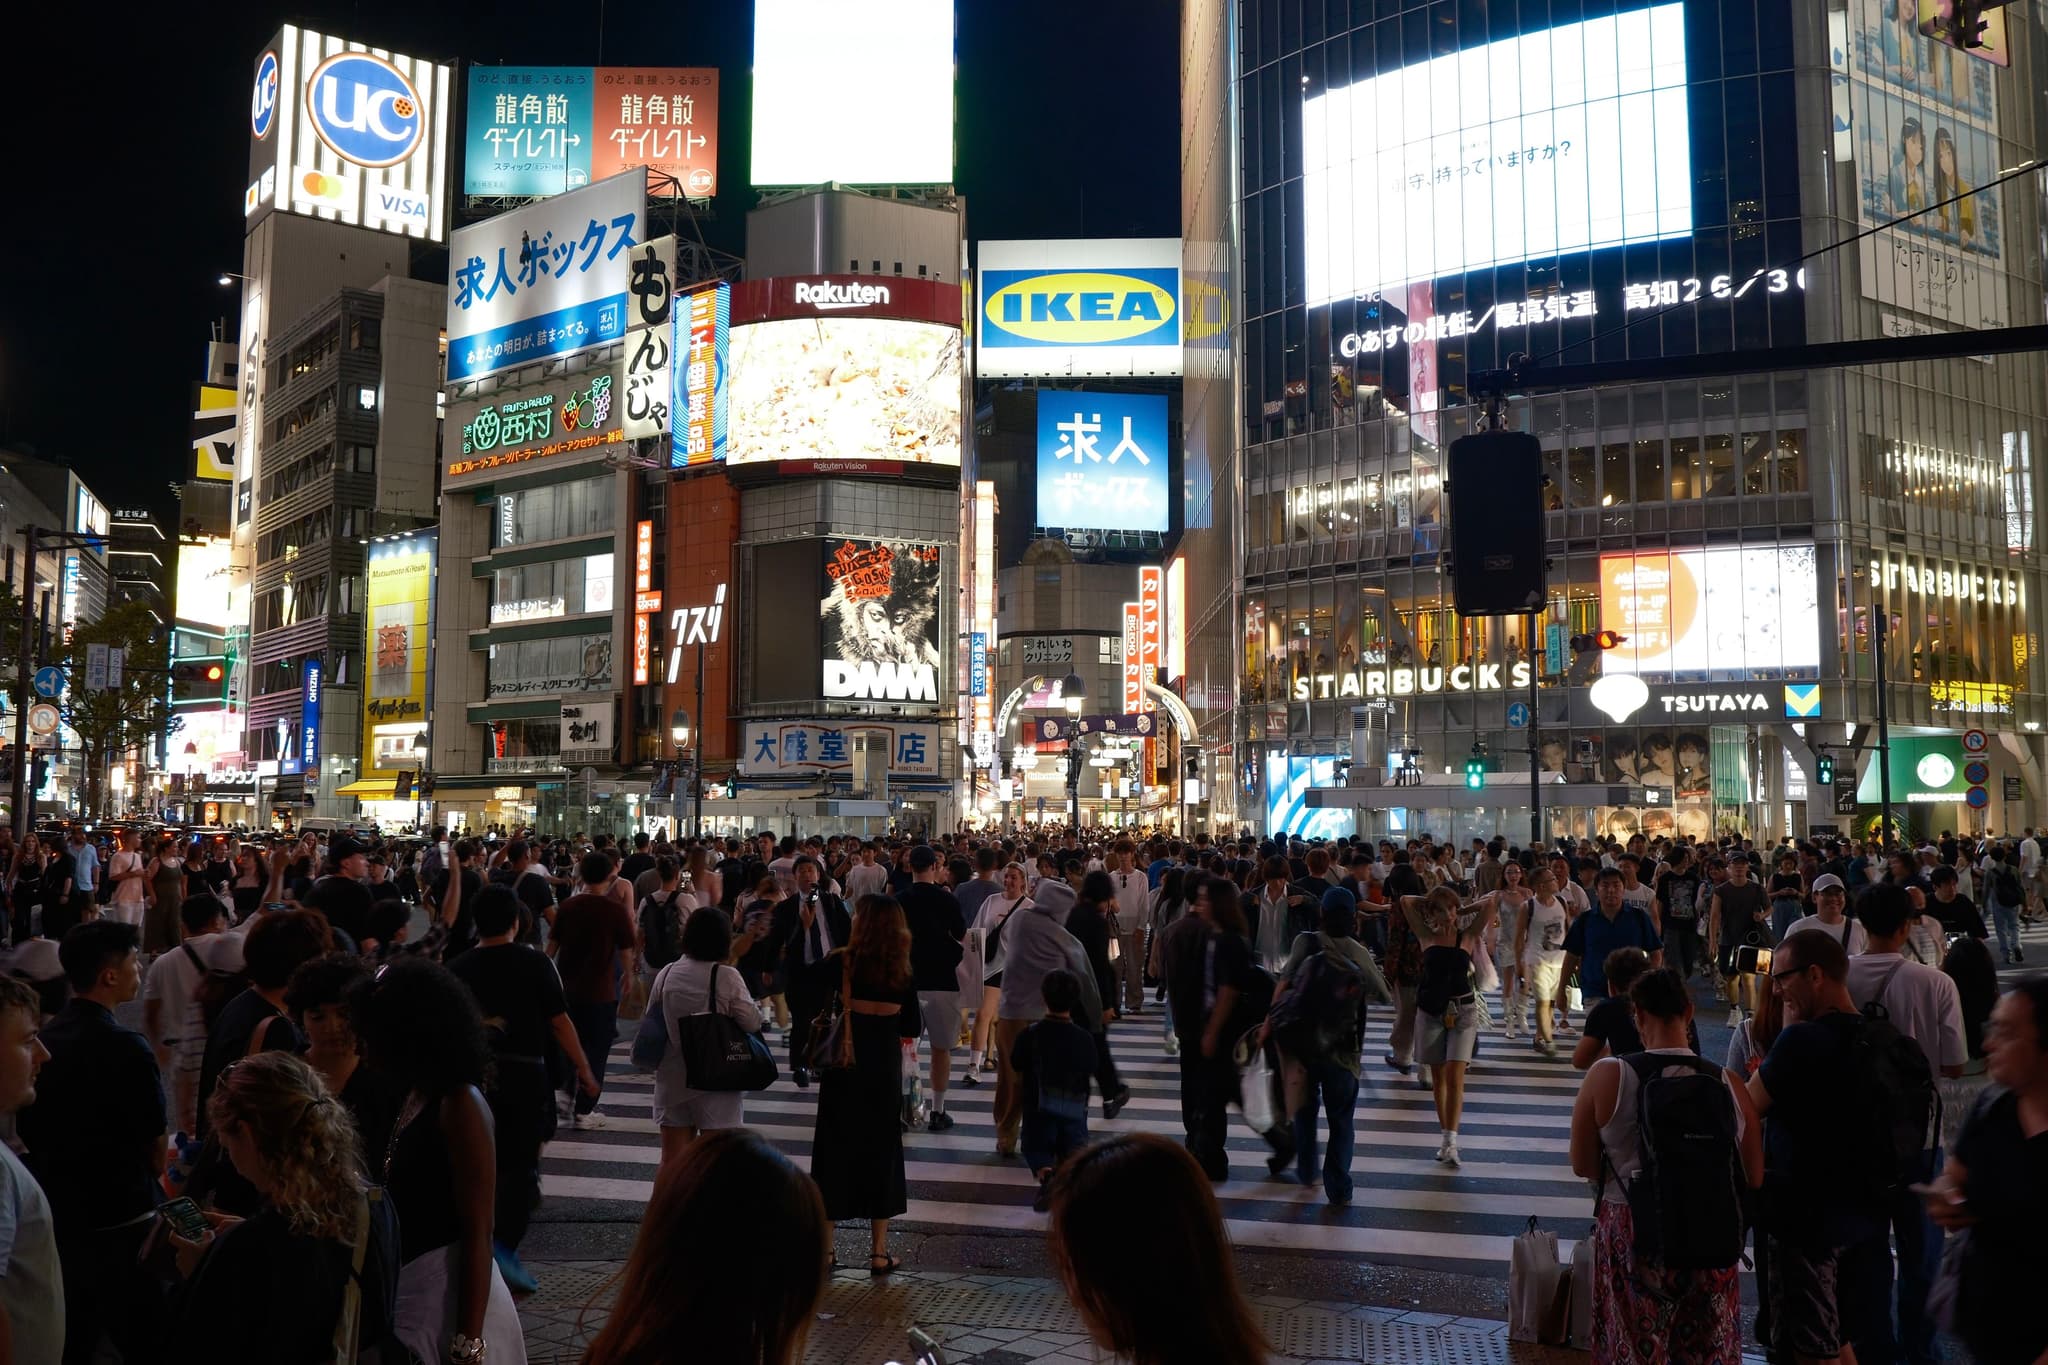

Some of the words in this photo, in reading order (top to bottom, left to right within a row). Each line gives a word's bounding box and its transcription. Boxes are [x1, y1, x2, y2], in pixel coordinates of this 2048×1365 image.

[322, 75, 412, 142] UC
[495, 94, 568, 125] 龍角散
[620, 94, 694, 125] 龍角散
[380, 194, 427, 218] VISA
[454, 213, 637, 310] 求人ボックス
[795, 281, 890, 309] Rakuten
[1002, 292, 1163, 322] IKEA
[467, 322, 589, 364] あなたの明日が、詰まってる。
[627, 246, 671, 430] もんじゃ
[502, 408, 553, 446] 西村
[1054, 412, 1150, 466] 求人
[814, 462, 845, 472] Rakuten
[847, 461, 867, 471] Vision
[1870, 560, 2018, 605] STARBUCKS
[1143, 578, 1159, 654] カラオケ
[377, 624, 407, 667] 薬
[1025, 652, 1072, 663] クリニック
[1037, 638, 1072, 650] れいわ
[309, 669, 318, 702] MIZUHO
[823, 659, 937, 700] DMM
[1294, 663, 1531, 700] STARBUCKS
[1661, 693, 1769, 713] TSUTAYA
[754, 732, 926, 764] 大盛堂店
